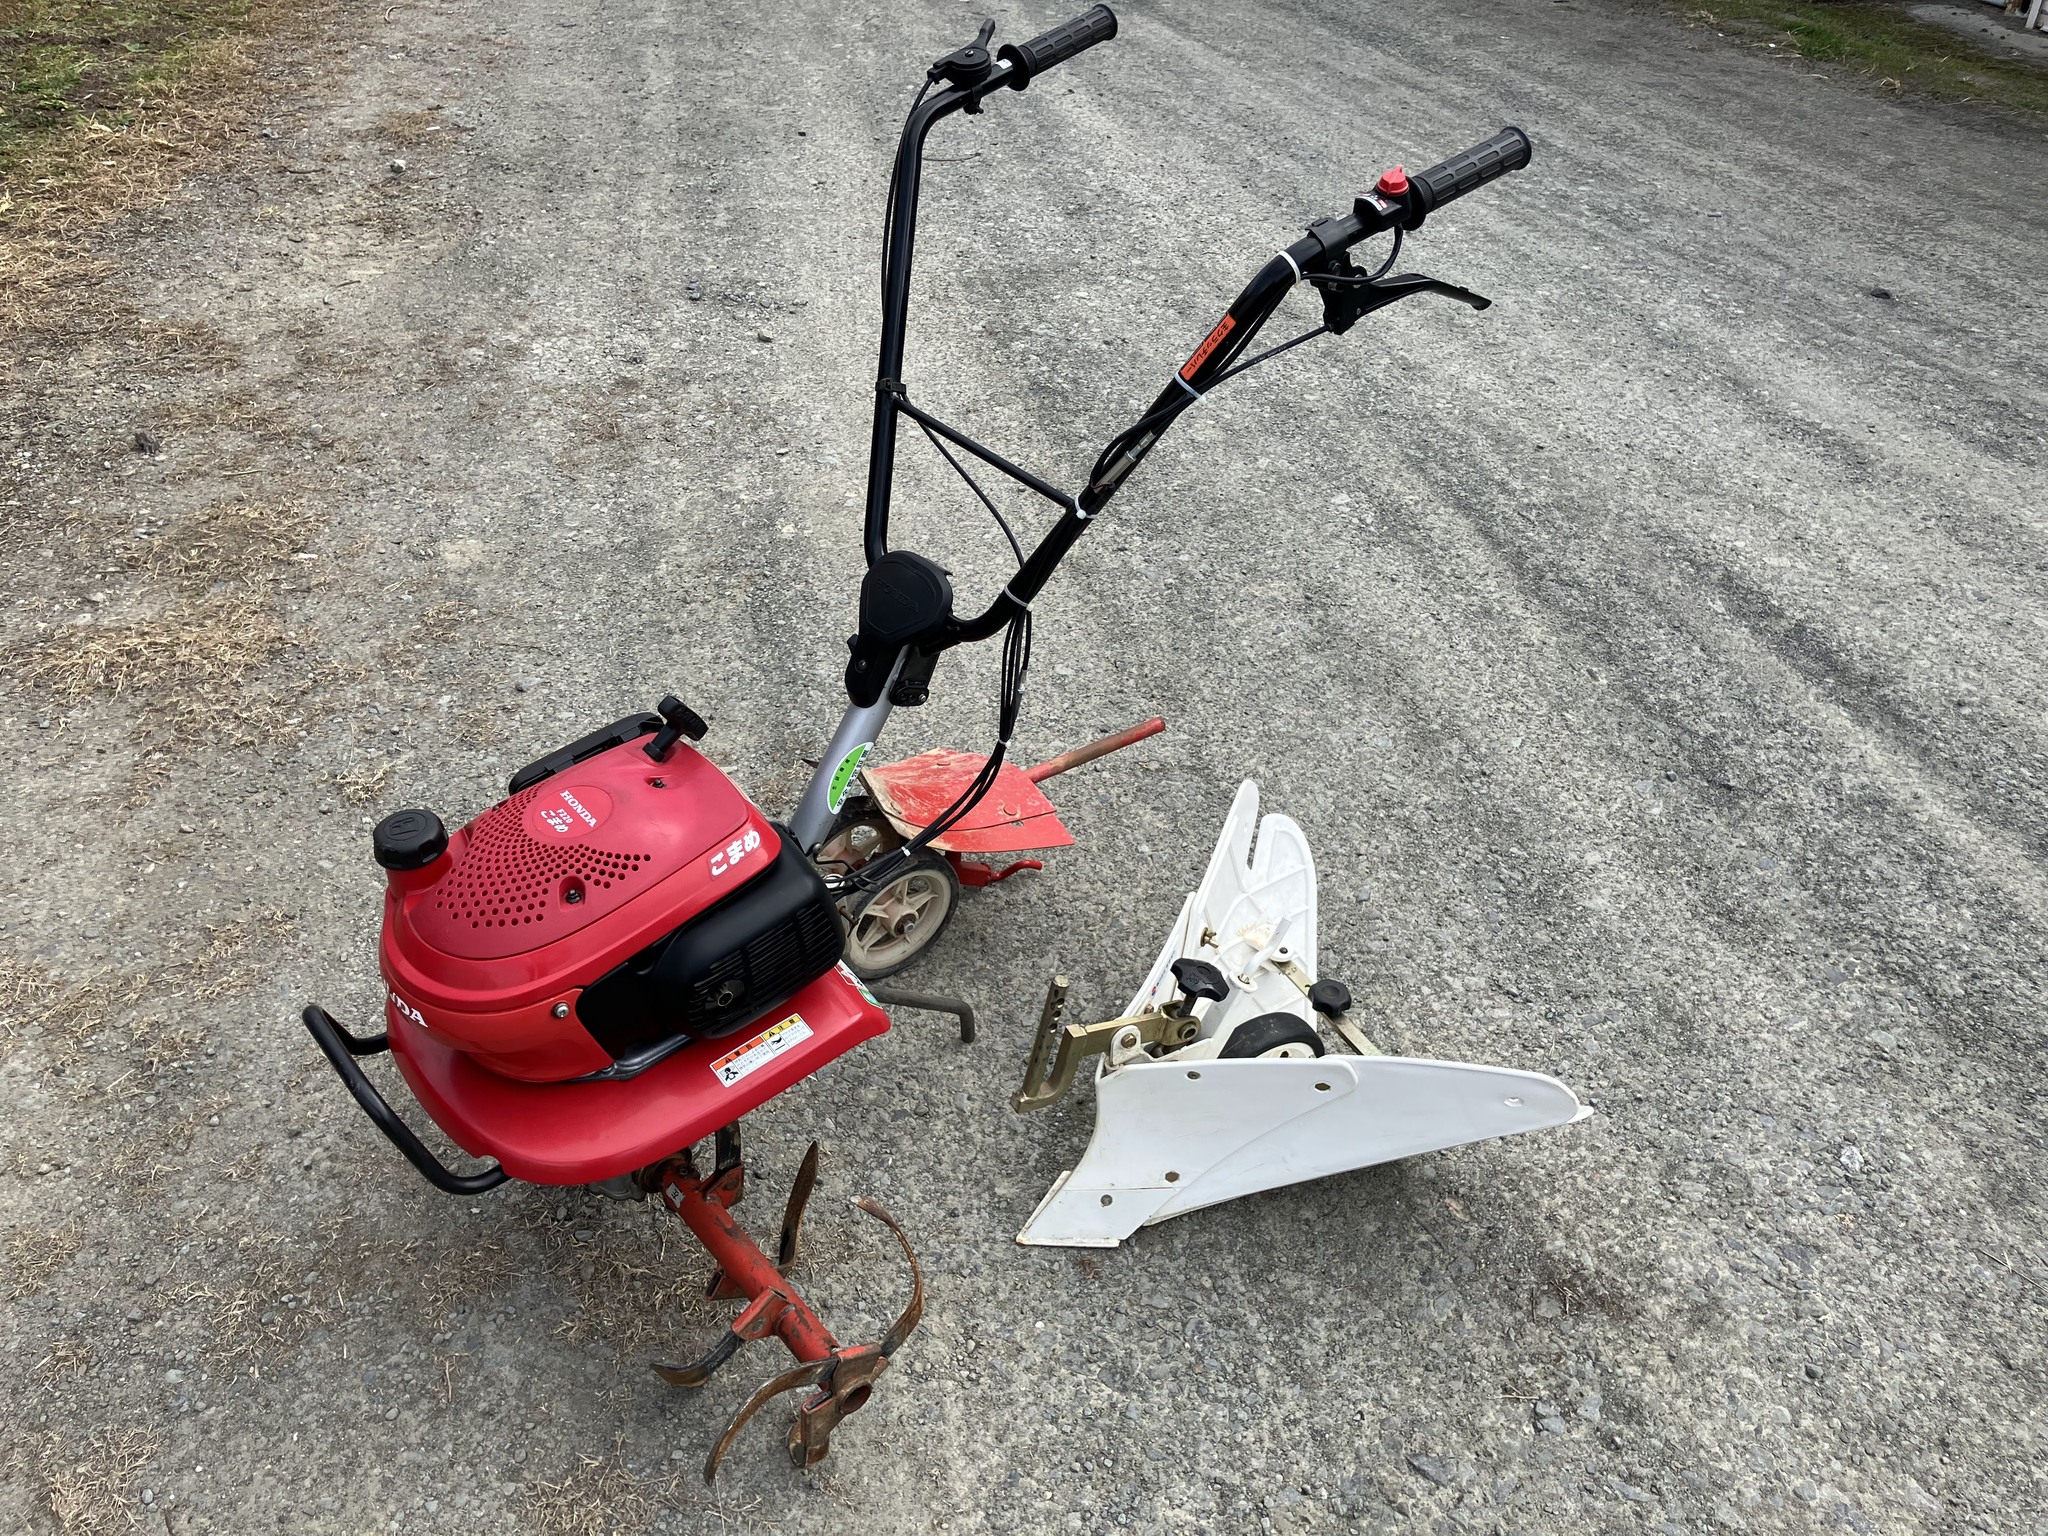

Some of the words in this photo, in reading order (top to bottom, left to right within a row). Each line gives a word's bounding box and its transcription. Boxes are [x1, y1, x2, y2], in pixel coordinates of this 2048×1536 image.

[1186, 321, 1229, 373] 主クラッチレバー
[540, 809, 570, 833] こまめ
[556, 808, 574, 824] F220
[559, 789, 598, 828] HONDA
[710, 829, 761, 876] こまめ
